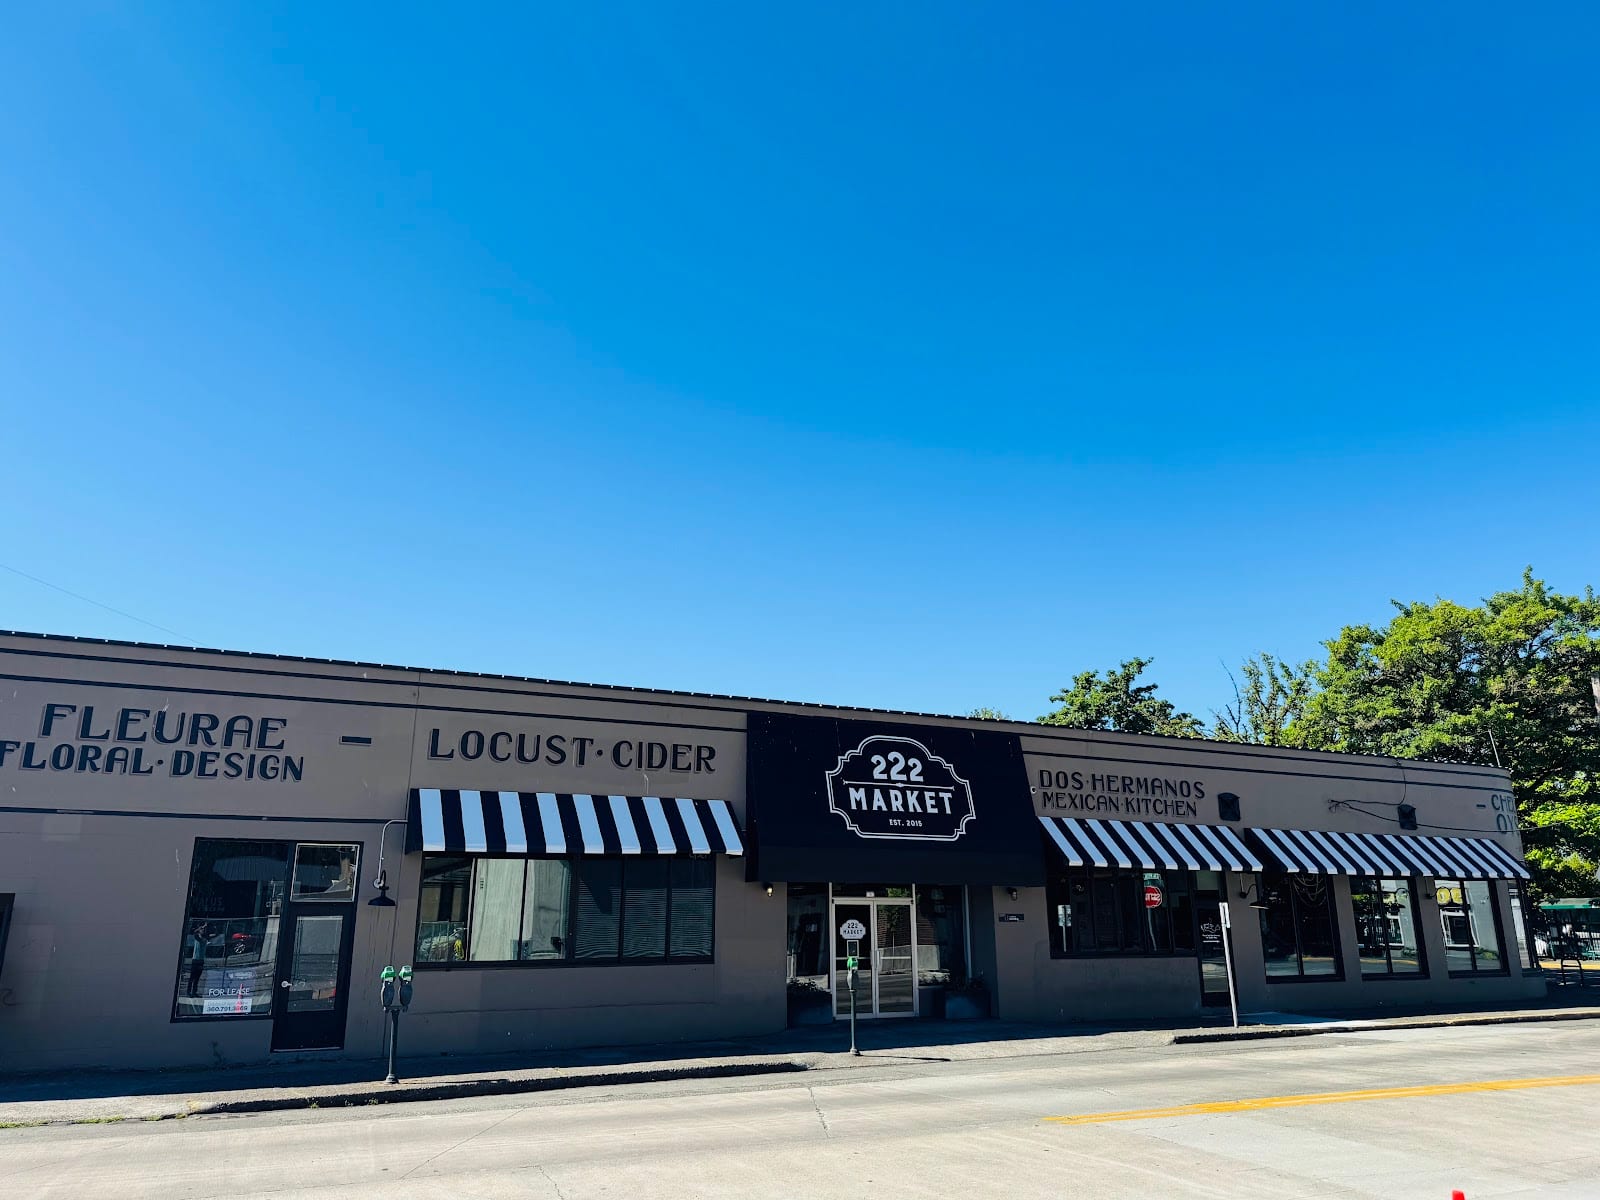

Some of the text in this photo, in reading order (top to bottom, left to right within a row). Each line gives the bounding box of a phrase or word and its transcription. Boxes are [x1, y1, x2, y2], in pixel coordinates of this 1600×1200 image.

[39, 703, 288, 750] FLEURAE
[0, 740, 304, 781] FLORAL DESIGN
[428, 728, 717, 774] LOCUST CIDER
[870, 751, 924, 782] 222
[1038, 769, 1206, 800] DOS HERMANOS
[848, 787, 953, 815] MARKET
[1042, 791, 1198, 818] MEXICAN KITCHEN
[906, 819, 923, 827] 2015
[208, 988, 250, 996] FOR LEASE
